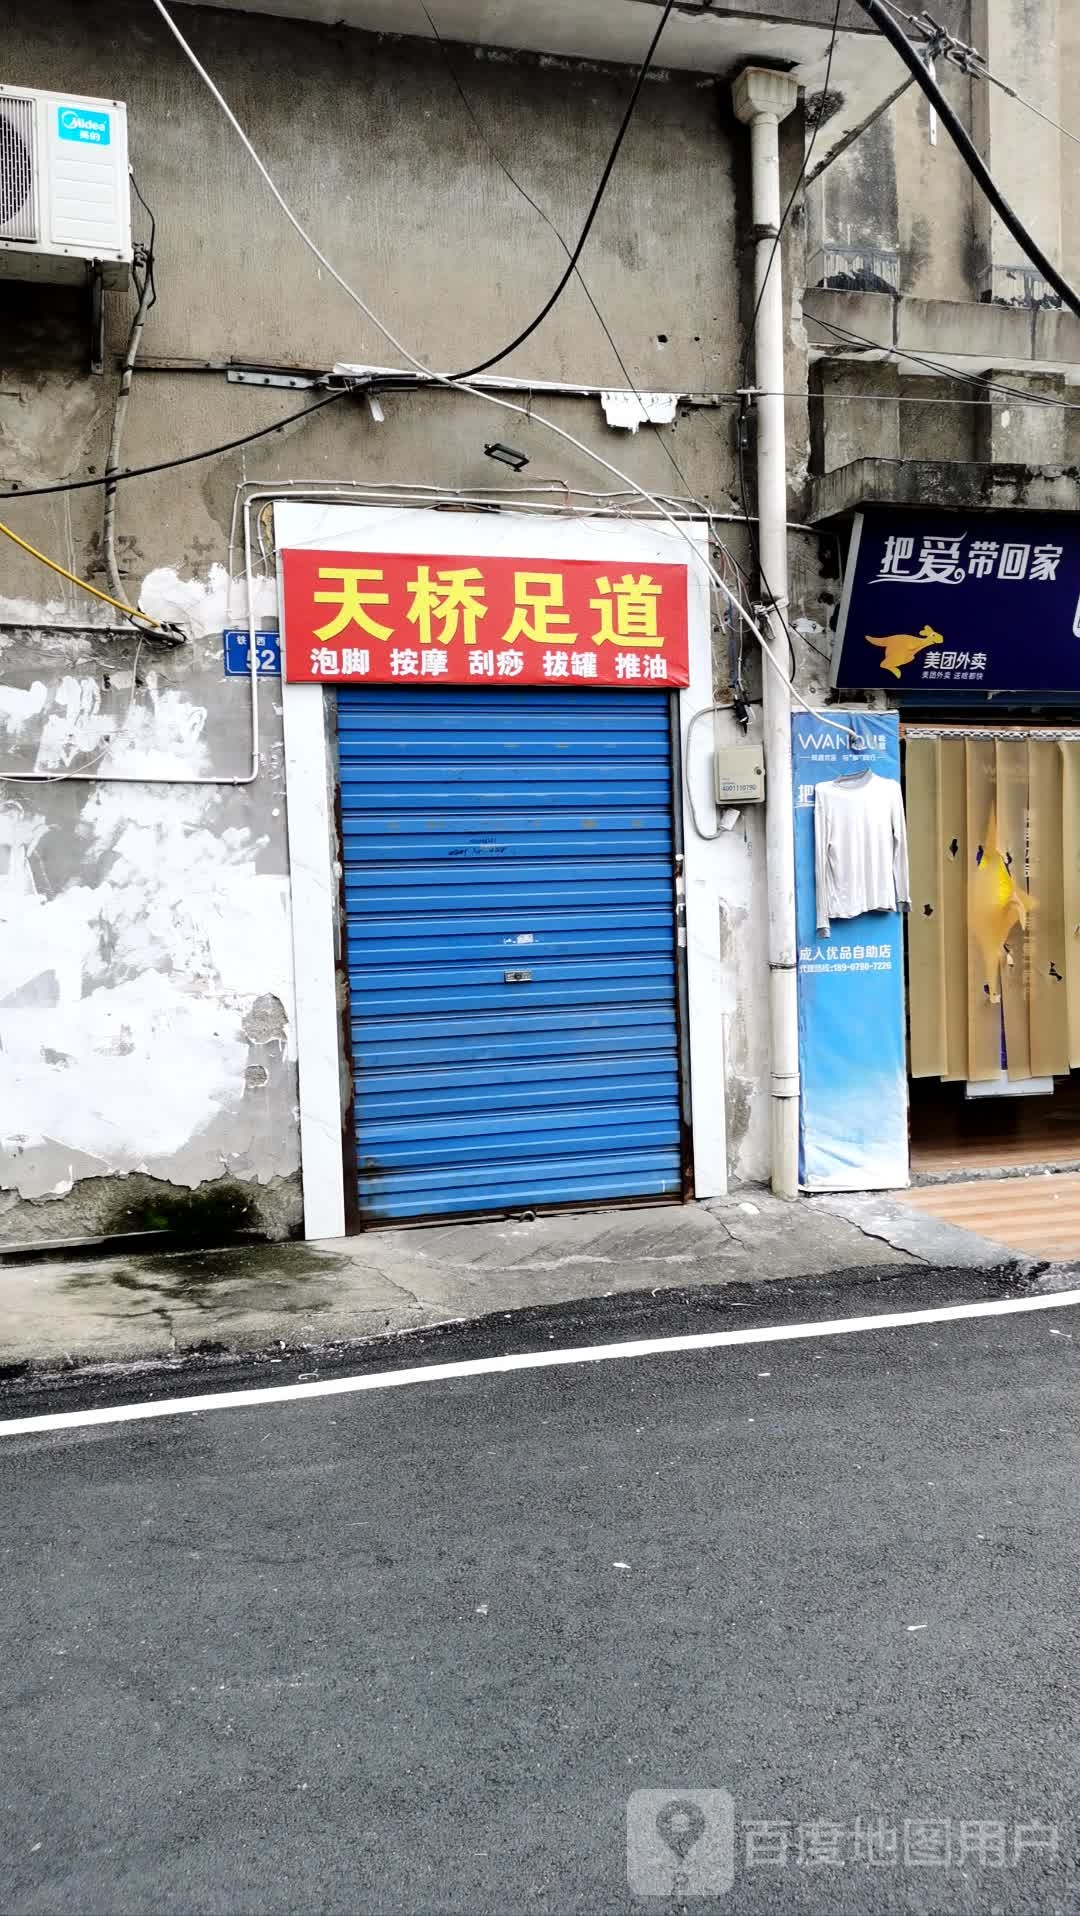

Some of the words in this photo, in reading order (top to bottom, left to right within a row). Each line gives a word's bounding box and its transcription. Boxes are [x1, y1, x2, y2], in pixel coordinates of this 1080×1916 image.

[66, 112, 106, 131] Midea
[868, 531, 1063, 584] 把爱带回家
[312, 565, 665, 648] 天桥足道
[246, 649, 276, 670] 52
[310, 647, 370, 676] 泡脚
[390, 648, 448, 676] 按摩
[468, 649, 524, 677] 刮痧
[543, 651, 598, 678] 拔罐
[615, 652, 668, 679] 推油
[923, 651, 987, 670] 美团外卖
[800, 944, 892, 961] 成人优品自助店
